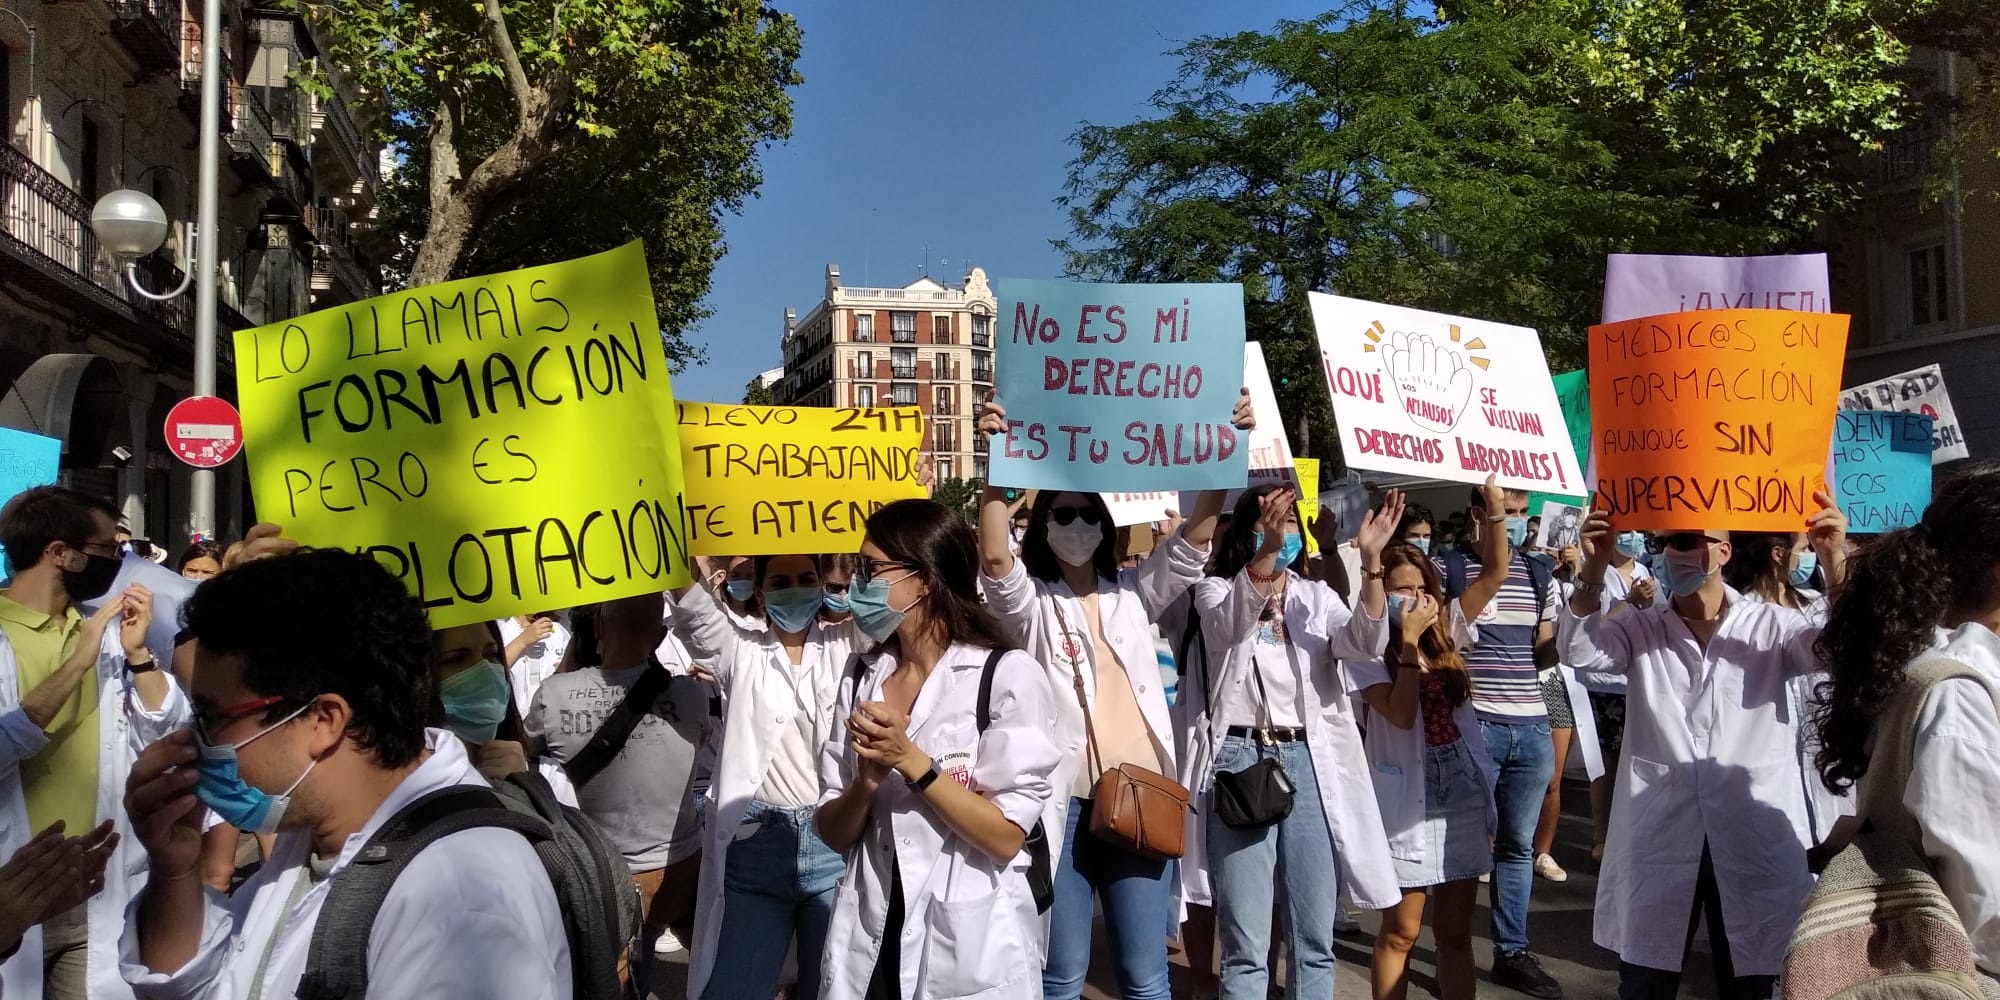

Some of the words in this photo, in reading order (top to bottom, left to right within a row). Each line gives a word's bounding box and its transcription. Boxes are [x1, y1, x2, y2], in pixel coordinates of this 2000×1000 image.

[254, 324, 310, 383] LO
[346, 279, 570, 361] LLAMÁIS
[1077, 304, 1127, 344] ES
[1604, 319, 1756, 362] MÉDIC@S
[1783, 320, 1820, 349] EN
[298, 321, 647, 443] FORMACIÓN
[1044, 356, 1203, 399] DERECHO
[1480, 387, 1498, 407] SE
[1613, 362, 1813, 408] FORMACIÓN
[678, 403, 797, 428] LLEVO
[831, 408, 922, 432] 24H
[1481, 407, 1544, 437] VUELVAN
[1836, 413, 1930, 443] DENTES
[1004, 419, 1049, 460] ES
[1123, 420, 1237, 467] SALUD
[1354, 427, 1444, 464] DERECHOS
[1455, 437, 1568, 489] LABORALES!
[1603, 428, 1689, 455] AUNQUE
[1713, 421, 1772, 456] SIN
[1834, 443, 1885, 465] HOY
[285, 451, 428, 518] PERO
[472, 434, 538, 485] ES
[693, 443, 919, 482] TRABAJANDO
[1598, 468, 1805, 516] SUPERVISIÓN
[1842, 473, 1886, 496] COS
[685, 504, 734, 540] TE
[1838, 501, 1918, 528] ÑANA
[300, 478, 691, 608] PLOTACIÓN
[568, 687, 598, 700] THE
[945, 764, 967, 775] UELGA
